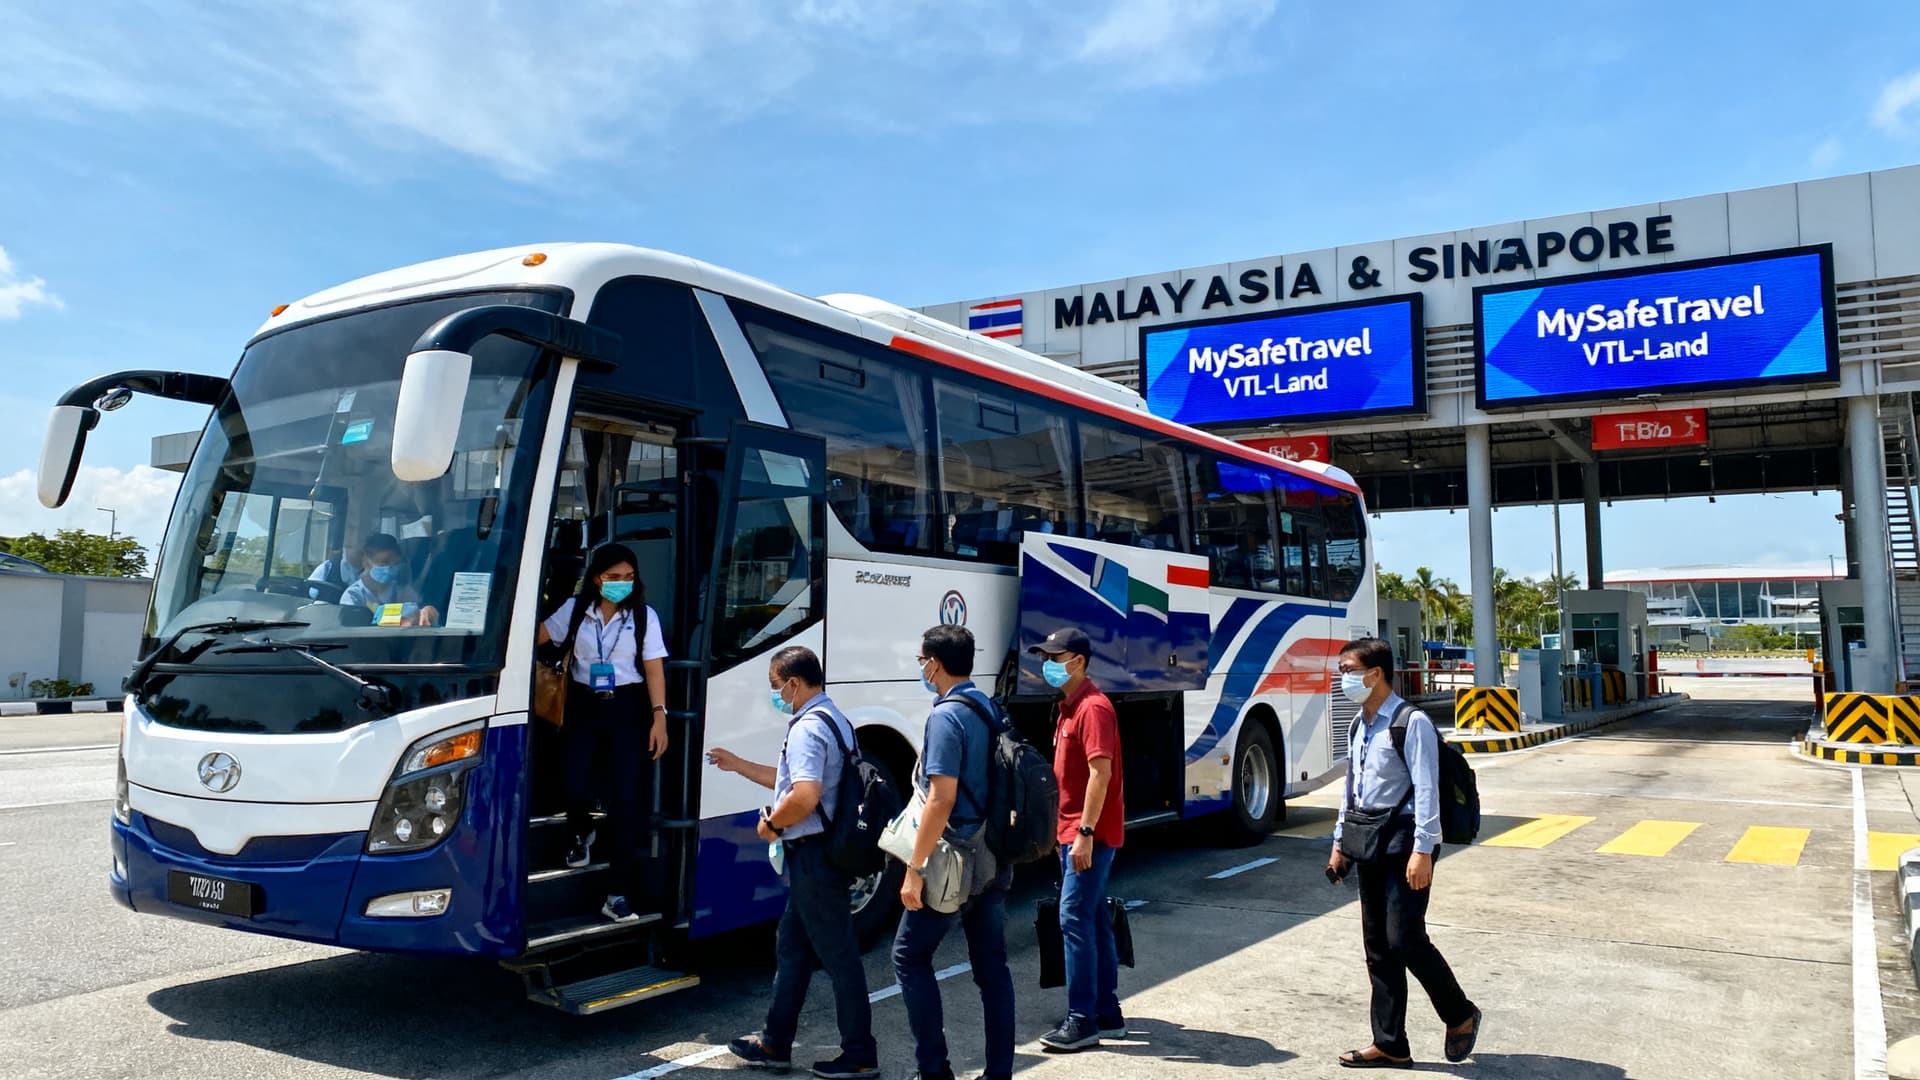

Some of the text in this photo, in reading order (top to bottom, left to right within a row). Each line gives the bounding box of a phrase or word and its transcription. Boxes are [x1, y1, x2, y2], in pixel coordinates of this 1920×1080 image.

[1055, 262, 1322, 329] MALAYASIA
[1348, 255, 1382, 290] &
[1537, 285, 1765, 342] MySafeTravel
[1188, 327, 1372, 378] MySafeTravel
[1582, 331, 1709, 366] VTL-Land
[1223, 367, 1329, 399] VTL-Land
